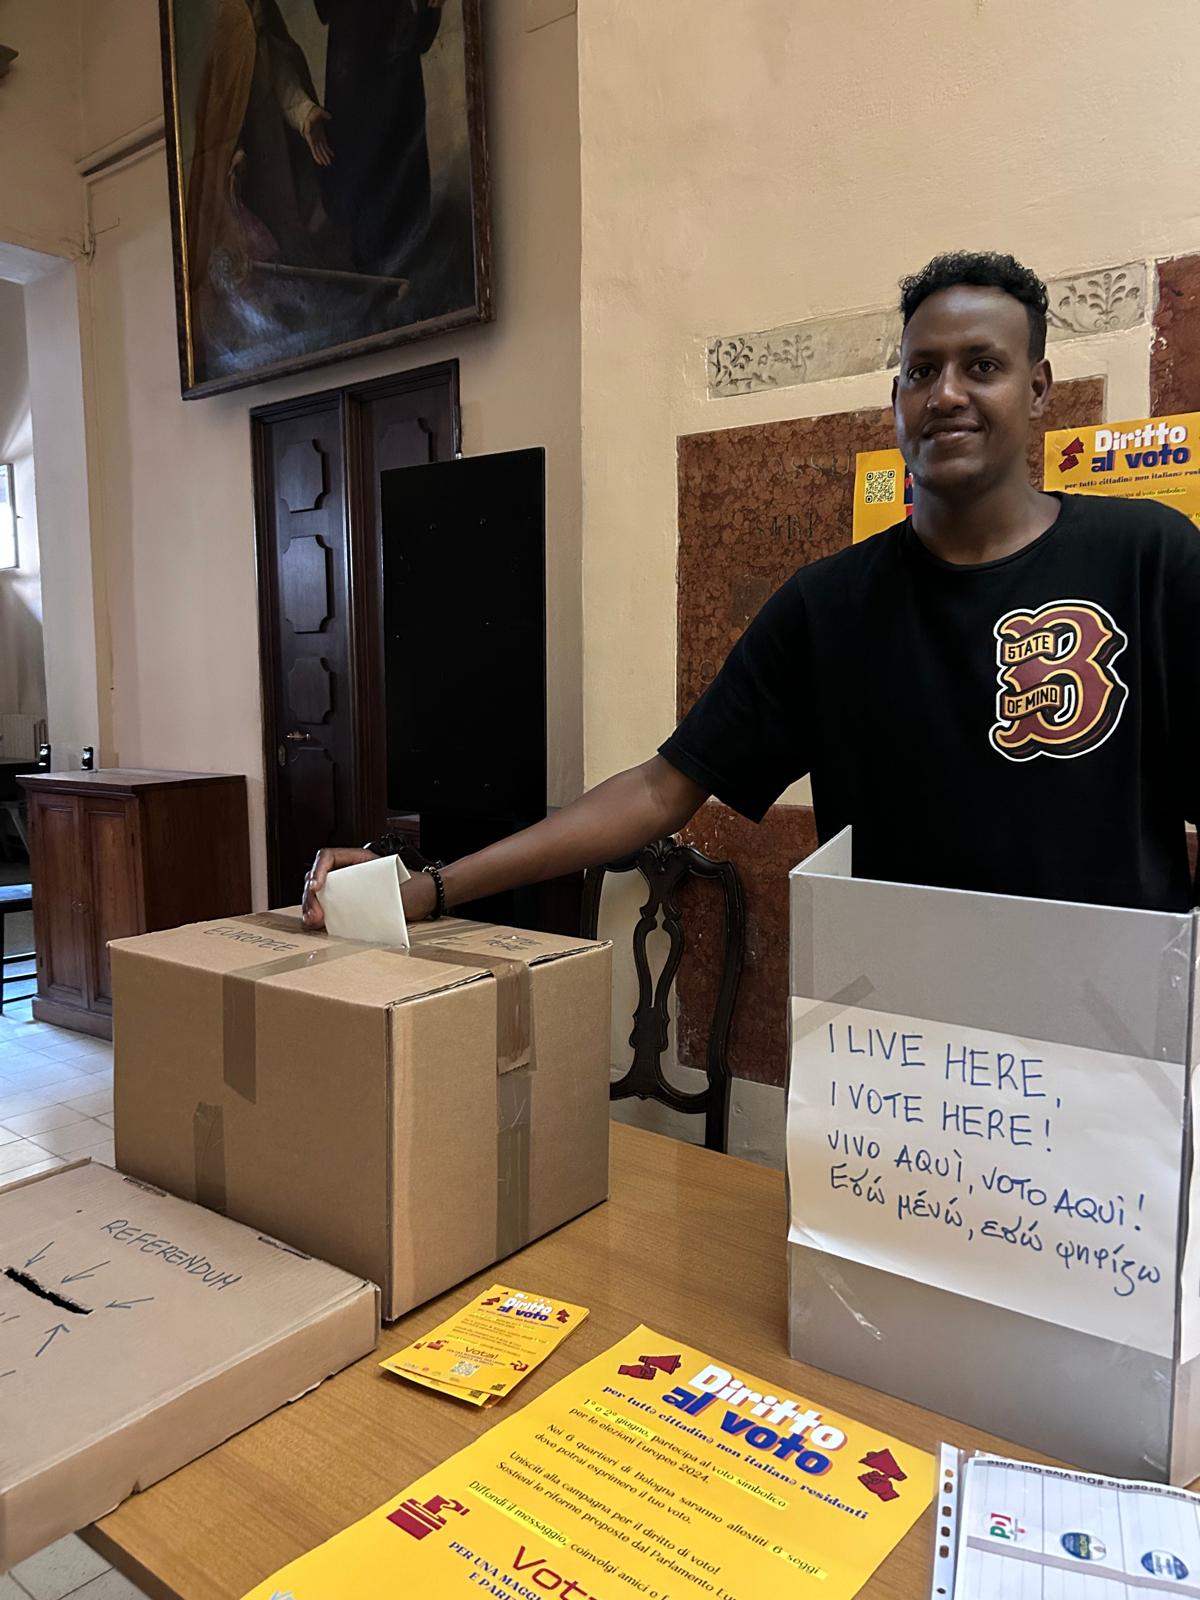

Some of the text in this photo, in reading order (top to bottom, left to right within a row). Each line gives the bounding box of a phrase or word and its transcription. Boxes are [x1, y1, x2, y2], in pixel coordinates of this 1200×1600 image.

[1091, 444, 1191, 473] al voto
[1095, 422, 1188, 452] Diritto
[1065, 482, 1077, 490] per
[1008, 635, 1050, 659] STATE
[1007, 687, 1058, 714] OF MIND
[203, 926, 299, 953] EUROPEE
[829, 1023, 835, 1053] I
[848, 1024, 926, 1068] LIVE
[831, 1081, 1053, 1153] I VOTE HERE!
[828, 1129, 880, 1159] VIVO
[982, 1167, 1047, 1206] VOTO
[100, 1219, 243, 1291] REFERENDUM
[496, 1305, 513, 1313] al
[516, 1309, 549, 1321] voto
[502, 1296, 553, 1315] Diritto
[465, 1346, 499, 1360] Vota!
[661, 1386, 833, 1477] al voto
[688, 1364, 847, 1451] Diritto
[568, 1407, 588, 1419] per
[599, 1421, 637, 1446] elezioni
[635, 1440, 677, 1467] Europee
[679, 1462, 710, 1484] 2024.
[602, 1385, 625, 1399] per
[716, 1443, 741, 1458] non
[800, 1483, 869, 1520] residenti
[615, 1417, 650, 1438] giugno,
[651, 1435, 698, 1463] partecipa
[699, 1459, 712, 1469] al
[712, 1466, 734, 1480] voto
[736, 1477, 787, 1508] simbolico
[534, 1432, 692, 1524] dove potrai esprimere il tuo voto.
[546, 1424, 822, 1576] Nei 6 quartieri di Bologna saranno allestiti 6 seggi
[1107, 1479, 1162, 1494] progetto
[469, 1480, 509, 1508] Diffondi
[506, 1503, 518, 1512] il
[514, 1508, 567, 1546] messaggio,
[570, 1543, 620, 1575] coinvolgi
[618, 1569, 651, 1593] amici
[496, 1461, 536, 1486] Sostieni
[533, 1482, 544, 1492] le
[544, 1490, 582, 1515] riforme
[581, 1511, 630, 1543] proposte
[631, 1540, 651, 1553] dal
[650, 1550, 714, 1592] Parlamento
[509, 1450, 721, 1575] Unisciti alla campagna per il diritto di voto!
[448, 1541, 475, 1560] PER
[474, 1557, 499, 1577] UNA
[468, 1571, 480, 1582] E
[513, 1545, 598, 1600] Vot
